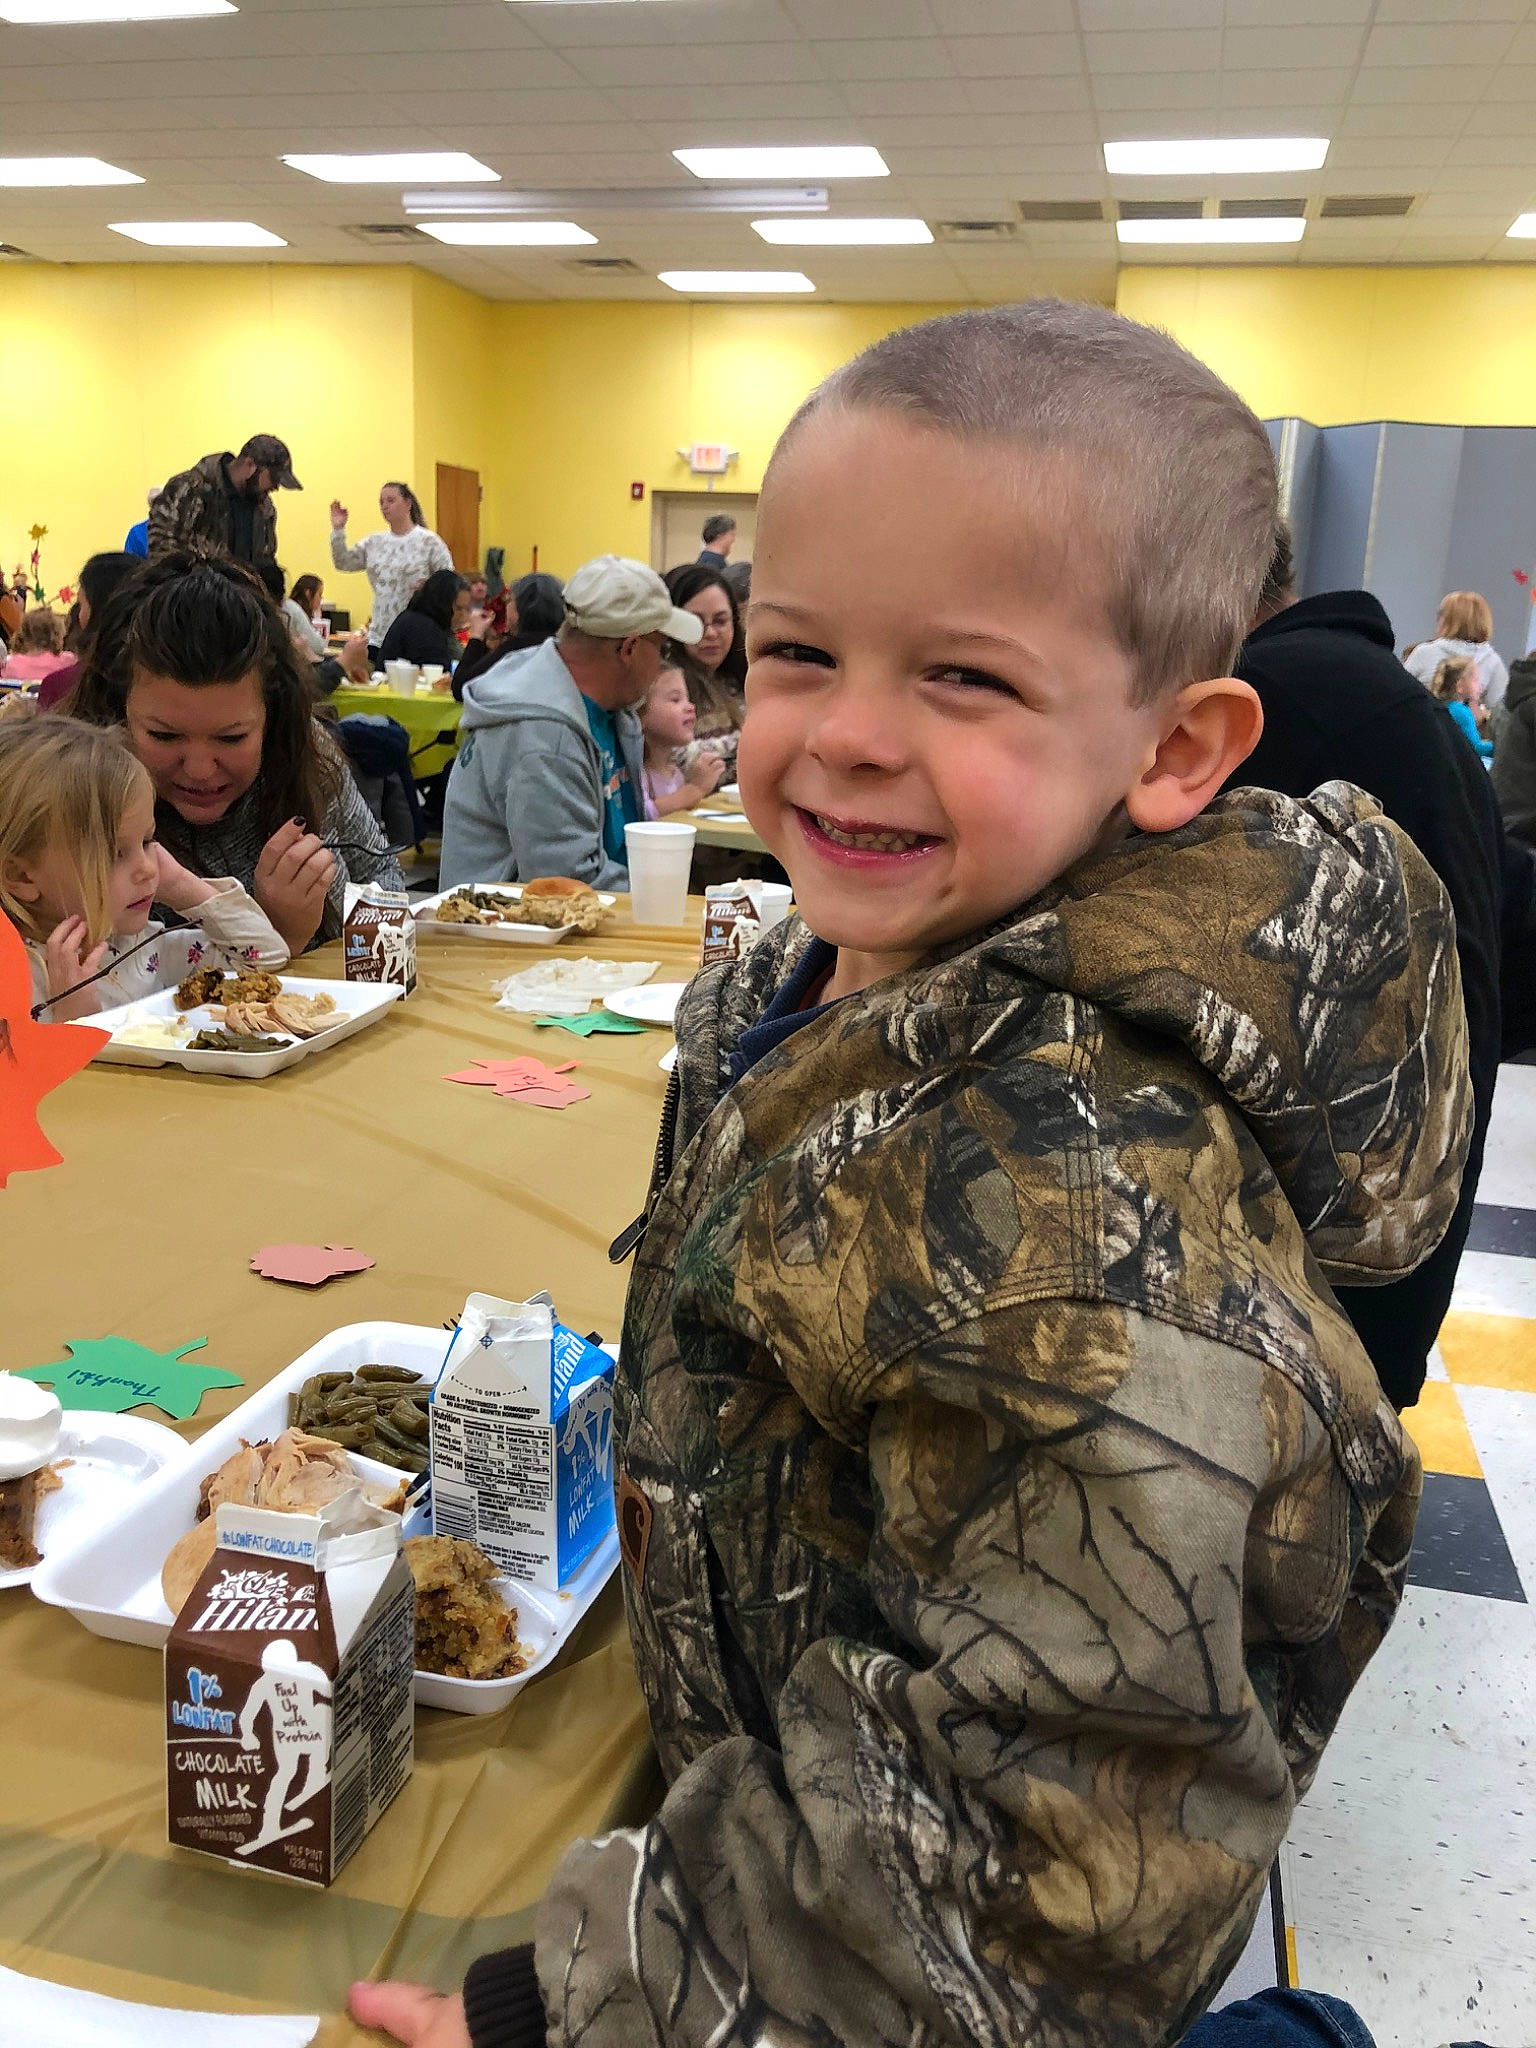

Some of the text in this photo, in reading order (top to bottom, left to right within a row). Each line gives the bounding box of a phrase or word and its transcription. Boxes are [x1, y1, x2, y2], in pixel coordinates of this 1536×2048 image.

[348, 960, 381, 973] CHOCOLATE
[356, 970, 380, 982] MILK
[434, 1409, 461, 1425] Nutrition
[434, 1419, 451, 1432] Facts
[570, 1466, 595, 1507] LOWFAT
[569, 1490, 594, 1539] MILK
[231, 1531, 263, 1549] LOWFAT
[265, 1537, 312, 1558] CHOCOLATE
[187, 1597, 319, 1632] Hilan
[187, 1666, 222, 1704] 1%
[275, 1681, 298, 1697] Fuel
[172, 1701, 236, 1734] LOWFAT
[281, 1698, 298, 1720] Up
[282, 1714, 308, 1728] with
[275, 1730, 322, 1743] Protein
[175, 1751, 265, 1775] CHOCOLATE
[196, 1777, 257, 1810] MILK
